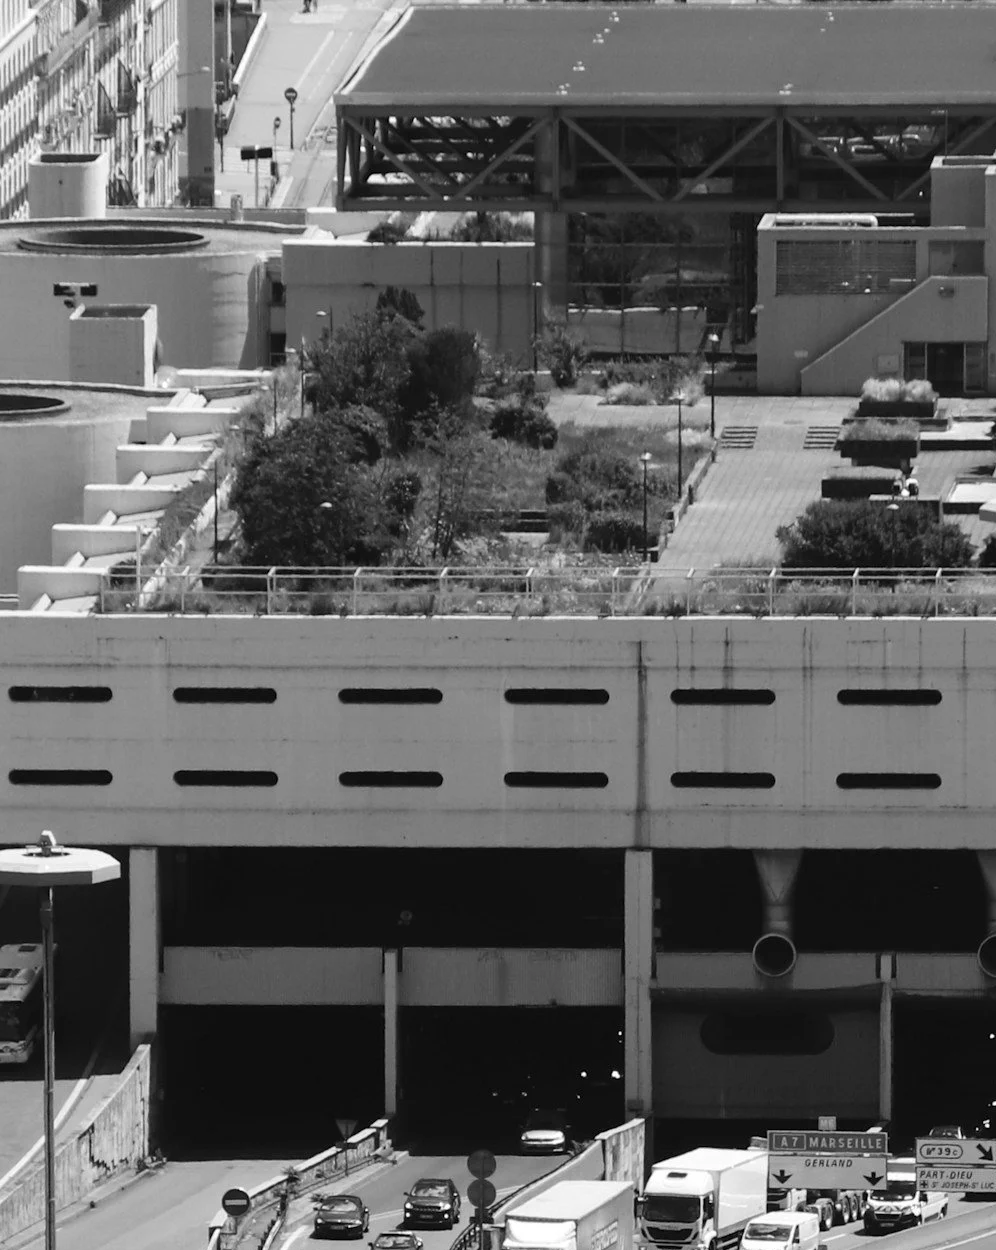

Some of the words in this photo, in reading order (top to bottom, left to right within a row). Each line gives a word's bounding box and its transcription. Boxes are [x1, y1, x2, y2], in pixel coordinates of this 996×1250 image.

[809, 1136, 883, 1150] MARSEILLE
[804, 1158, 853, 1168] GERLAND
[919, 1170, 973, 1180] PART-DIEU
[980, 1182, 995, 1190] LUC
